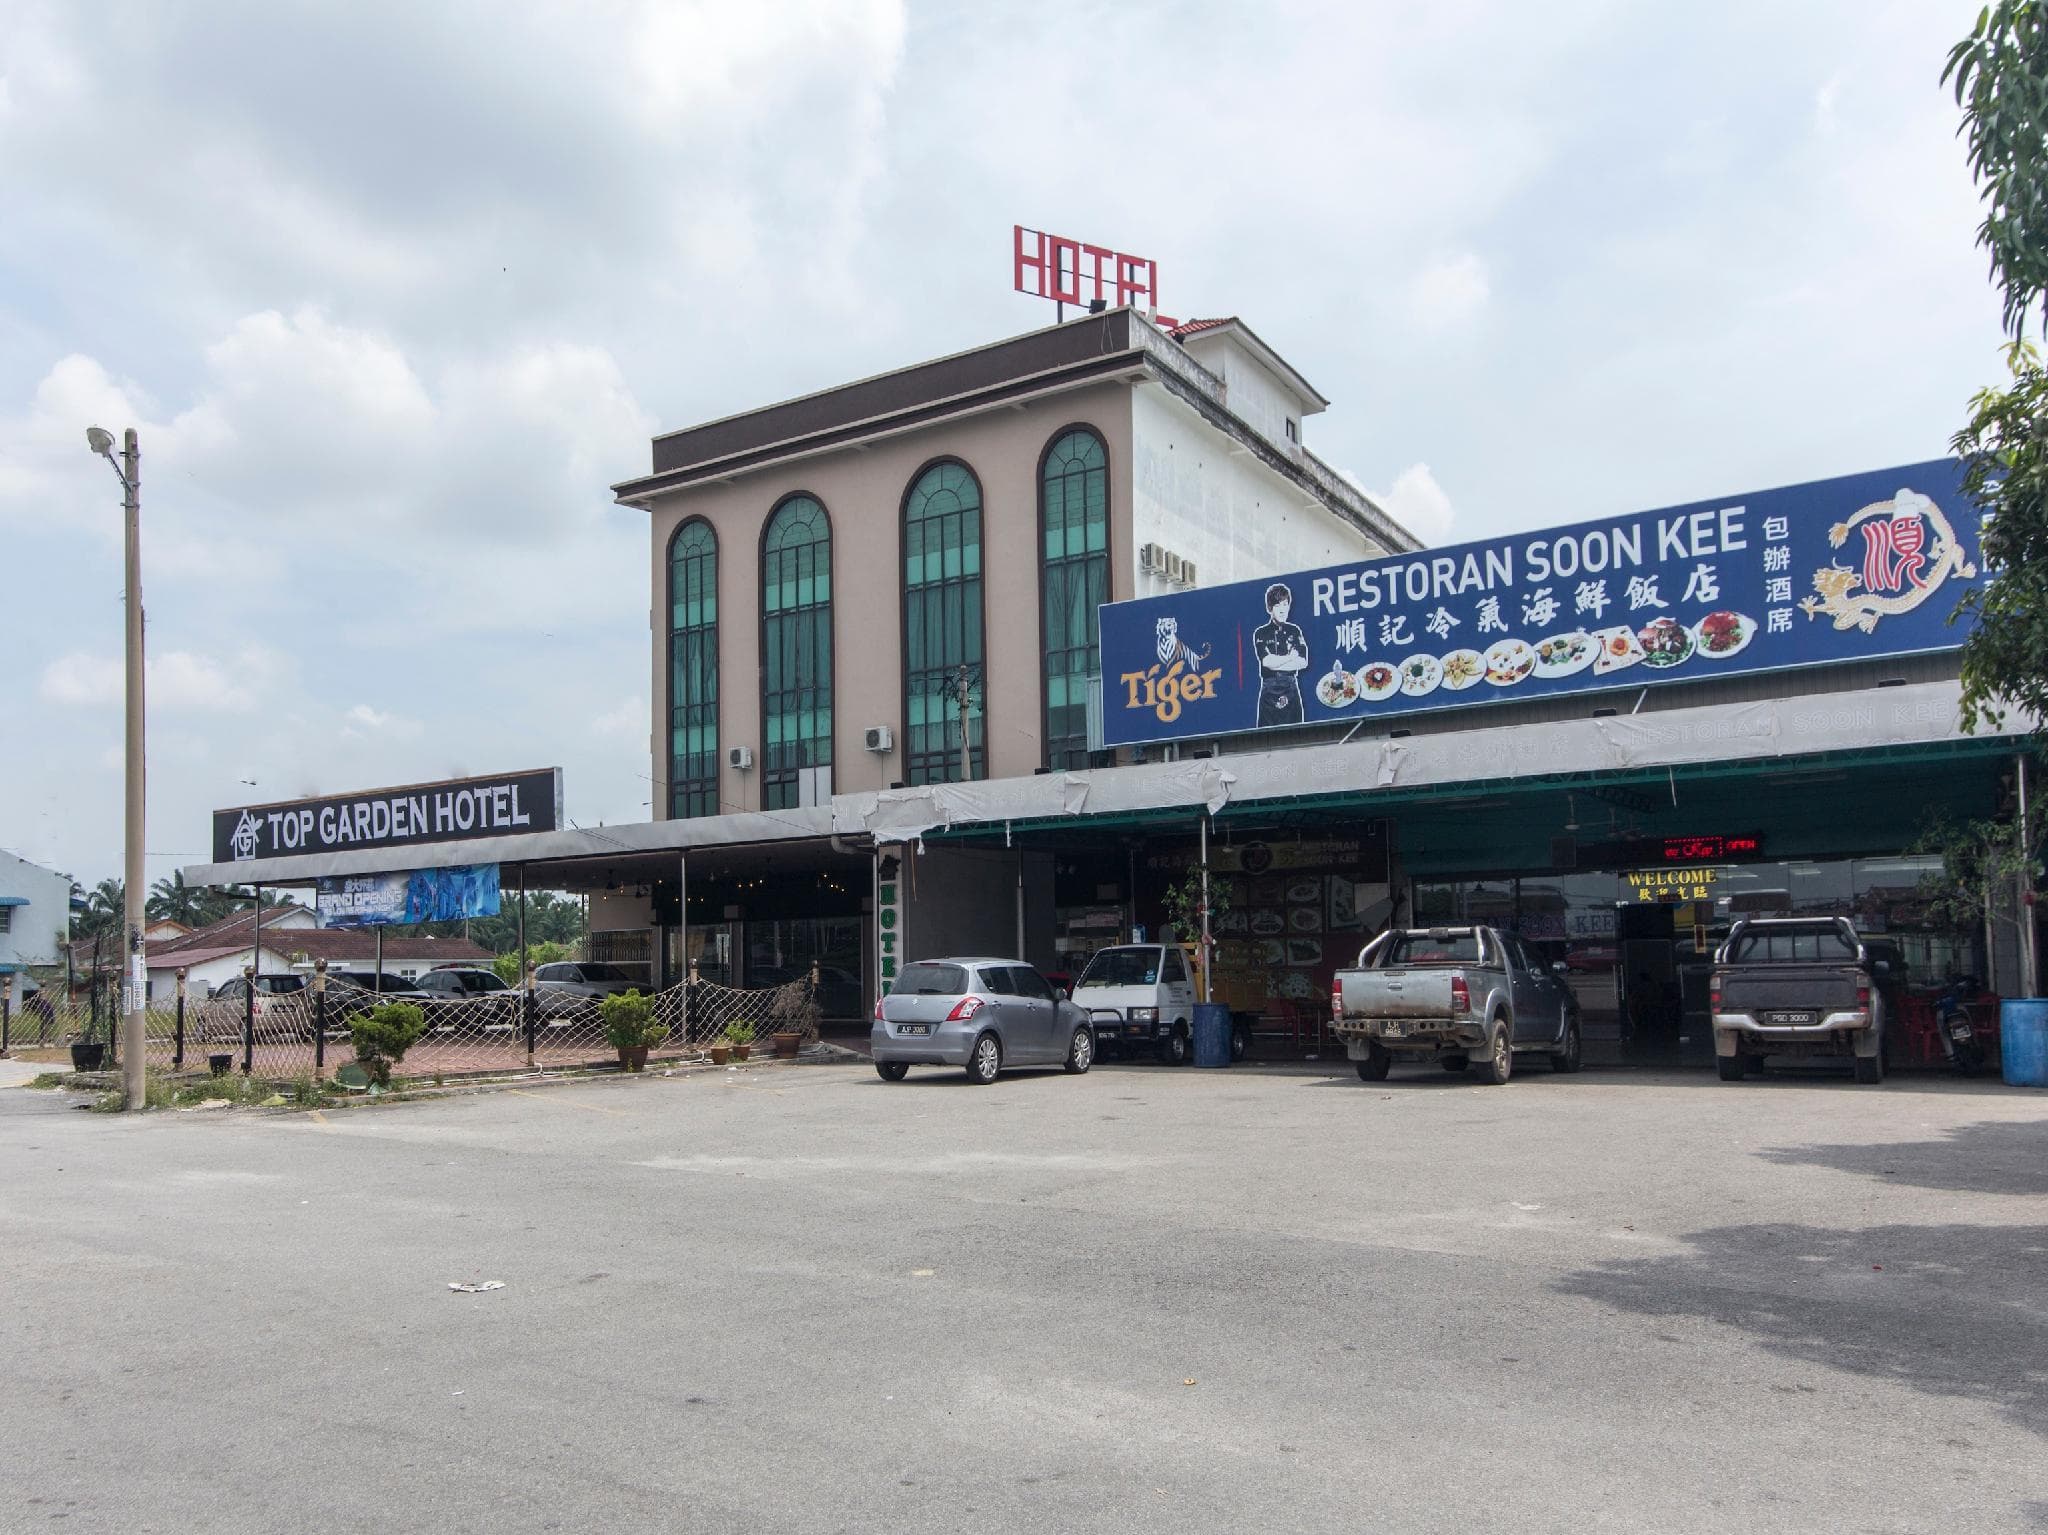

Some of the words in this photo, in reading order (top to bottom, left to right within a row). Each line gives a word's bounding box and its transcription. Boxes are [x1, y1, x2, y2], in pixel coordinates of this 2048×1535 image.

[1013, 224, 1179, 328] HOTEL
[1312, 546, 1513, 616] RESTORAN
[1525, 523, 1642, 583] SOON
[1657, 505, 1748, 563] KEE
[1761, 515, 1794, 633] 包辦酒席
[1120, 661, 1222, 722] Tiger
[1791, 704, 1875, 734] SOON
[1893, 700, 1950, 725] KEE
[267, 810, 314, 850] TOP
[319, 795, 428, 844] GARDEN
[434, 784, 530, 833] HOTEL
[1628, 869, 1718, 887] WELCOME
